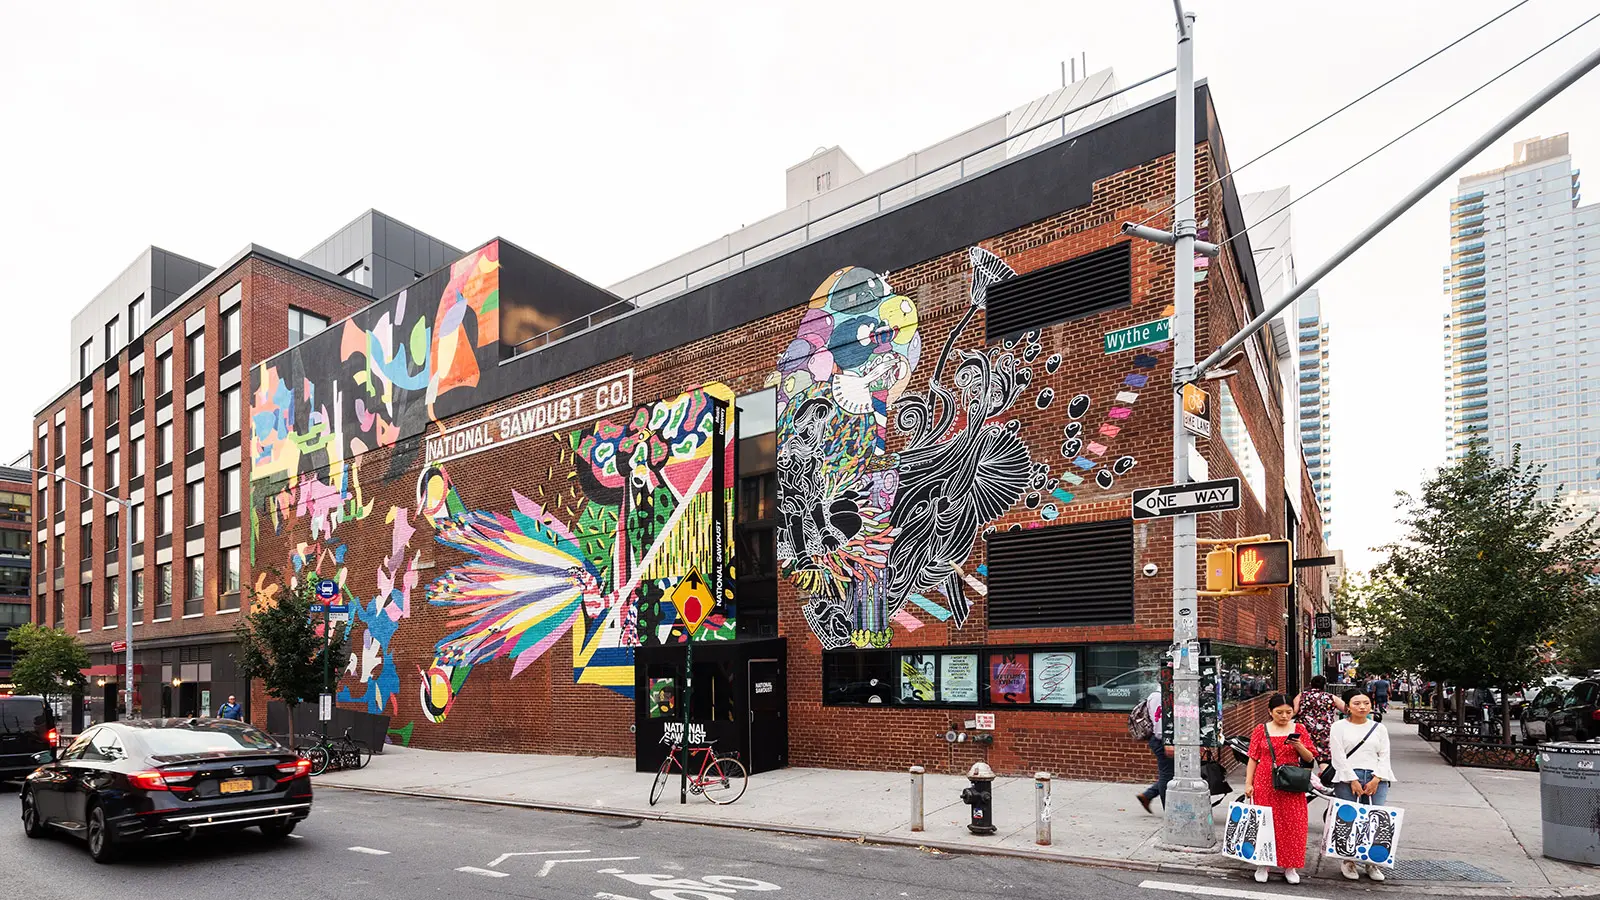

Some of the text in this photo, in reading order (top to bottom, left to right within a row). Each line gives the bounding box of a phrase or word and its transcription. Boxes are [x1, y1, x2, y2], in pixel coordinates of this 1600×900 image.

[1107, 321, 1169, 350] Wythe Av
[428, 381, 627, 460] NATIONAL SAWDUST CO.
[1184, 413, 1209, 434] BIKE LANE
[1146, 488, 1229, 509] ONE WAY
[664, 722, 706, 734] NATINAL
[664, 732, 706, 744] SAWUST
